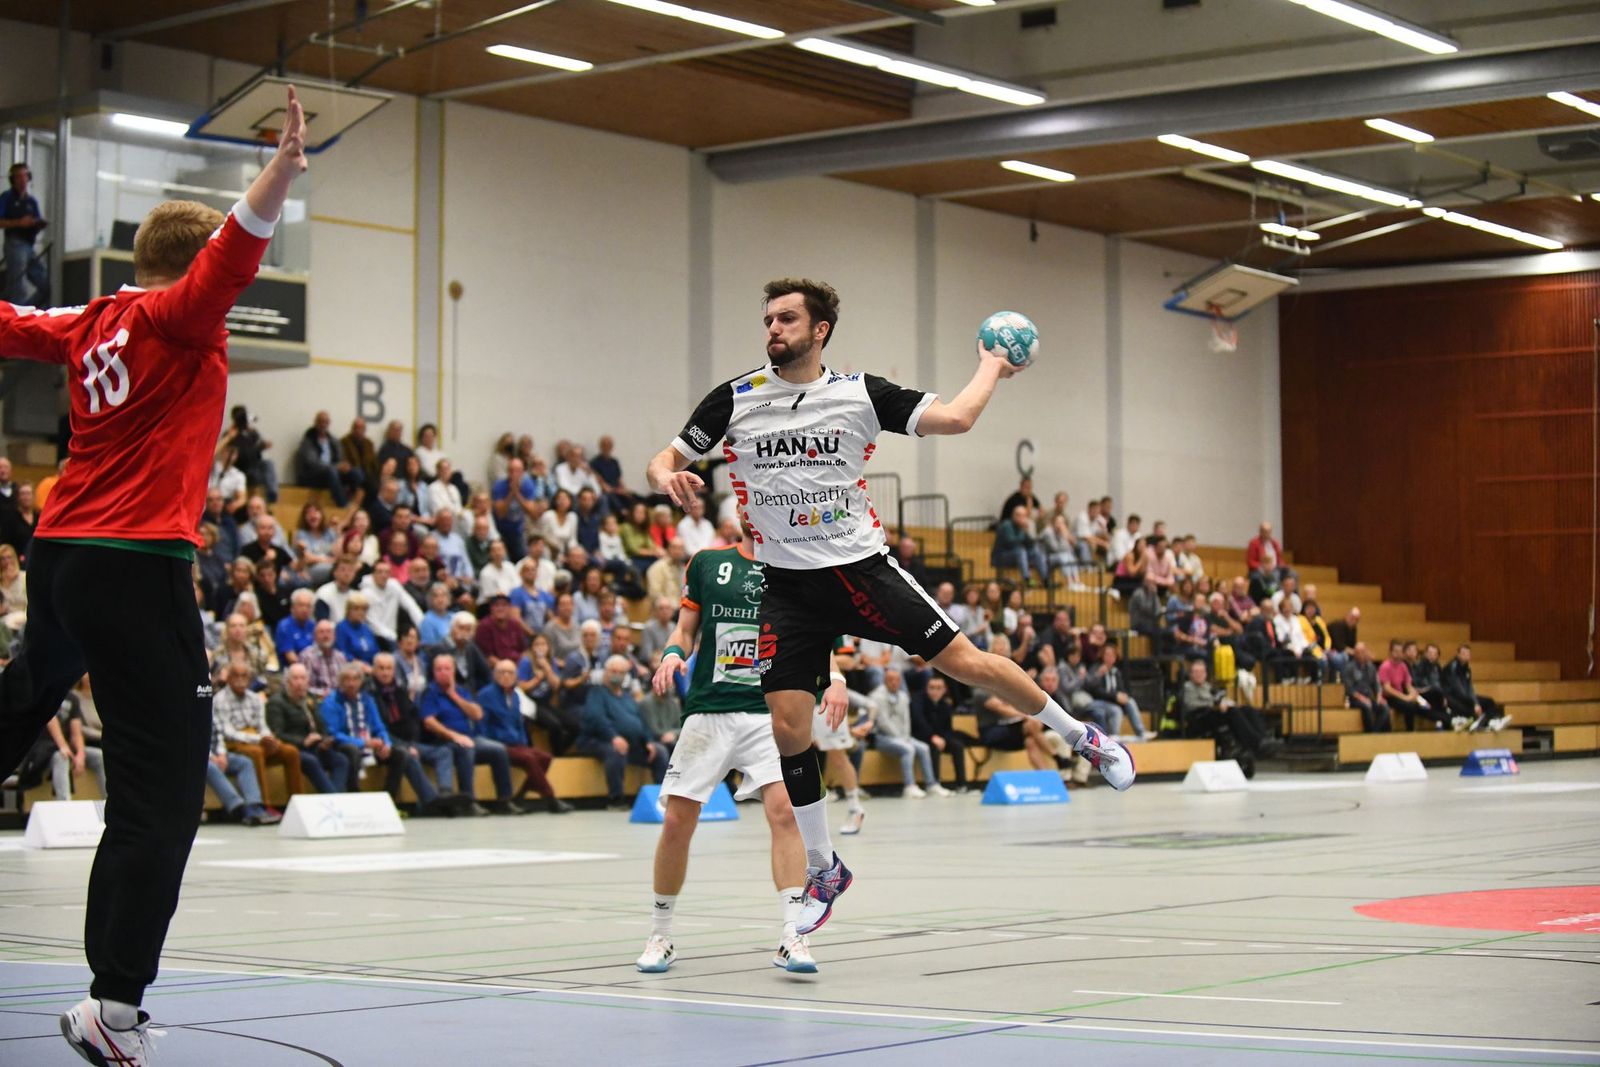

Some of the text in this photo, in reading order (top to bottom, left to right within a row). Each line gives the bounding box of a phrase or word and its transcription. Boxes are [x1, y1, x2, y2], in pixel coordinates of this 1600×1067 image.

[999, 328, 1027, 363] SELECT
[83, 327, 130, 414] 16
[356, 373, 386, 424] B
[756, 436, 840, 459] HANAU
[1016, 439, 1035, 477] C
[753, 458, 848, 470] www.bau-hanau.de
[716, 561, 733, 585] 9
[924, 619, 943, 639] JAKO
